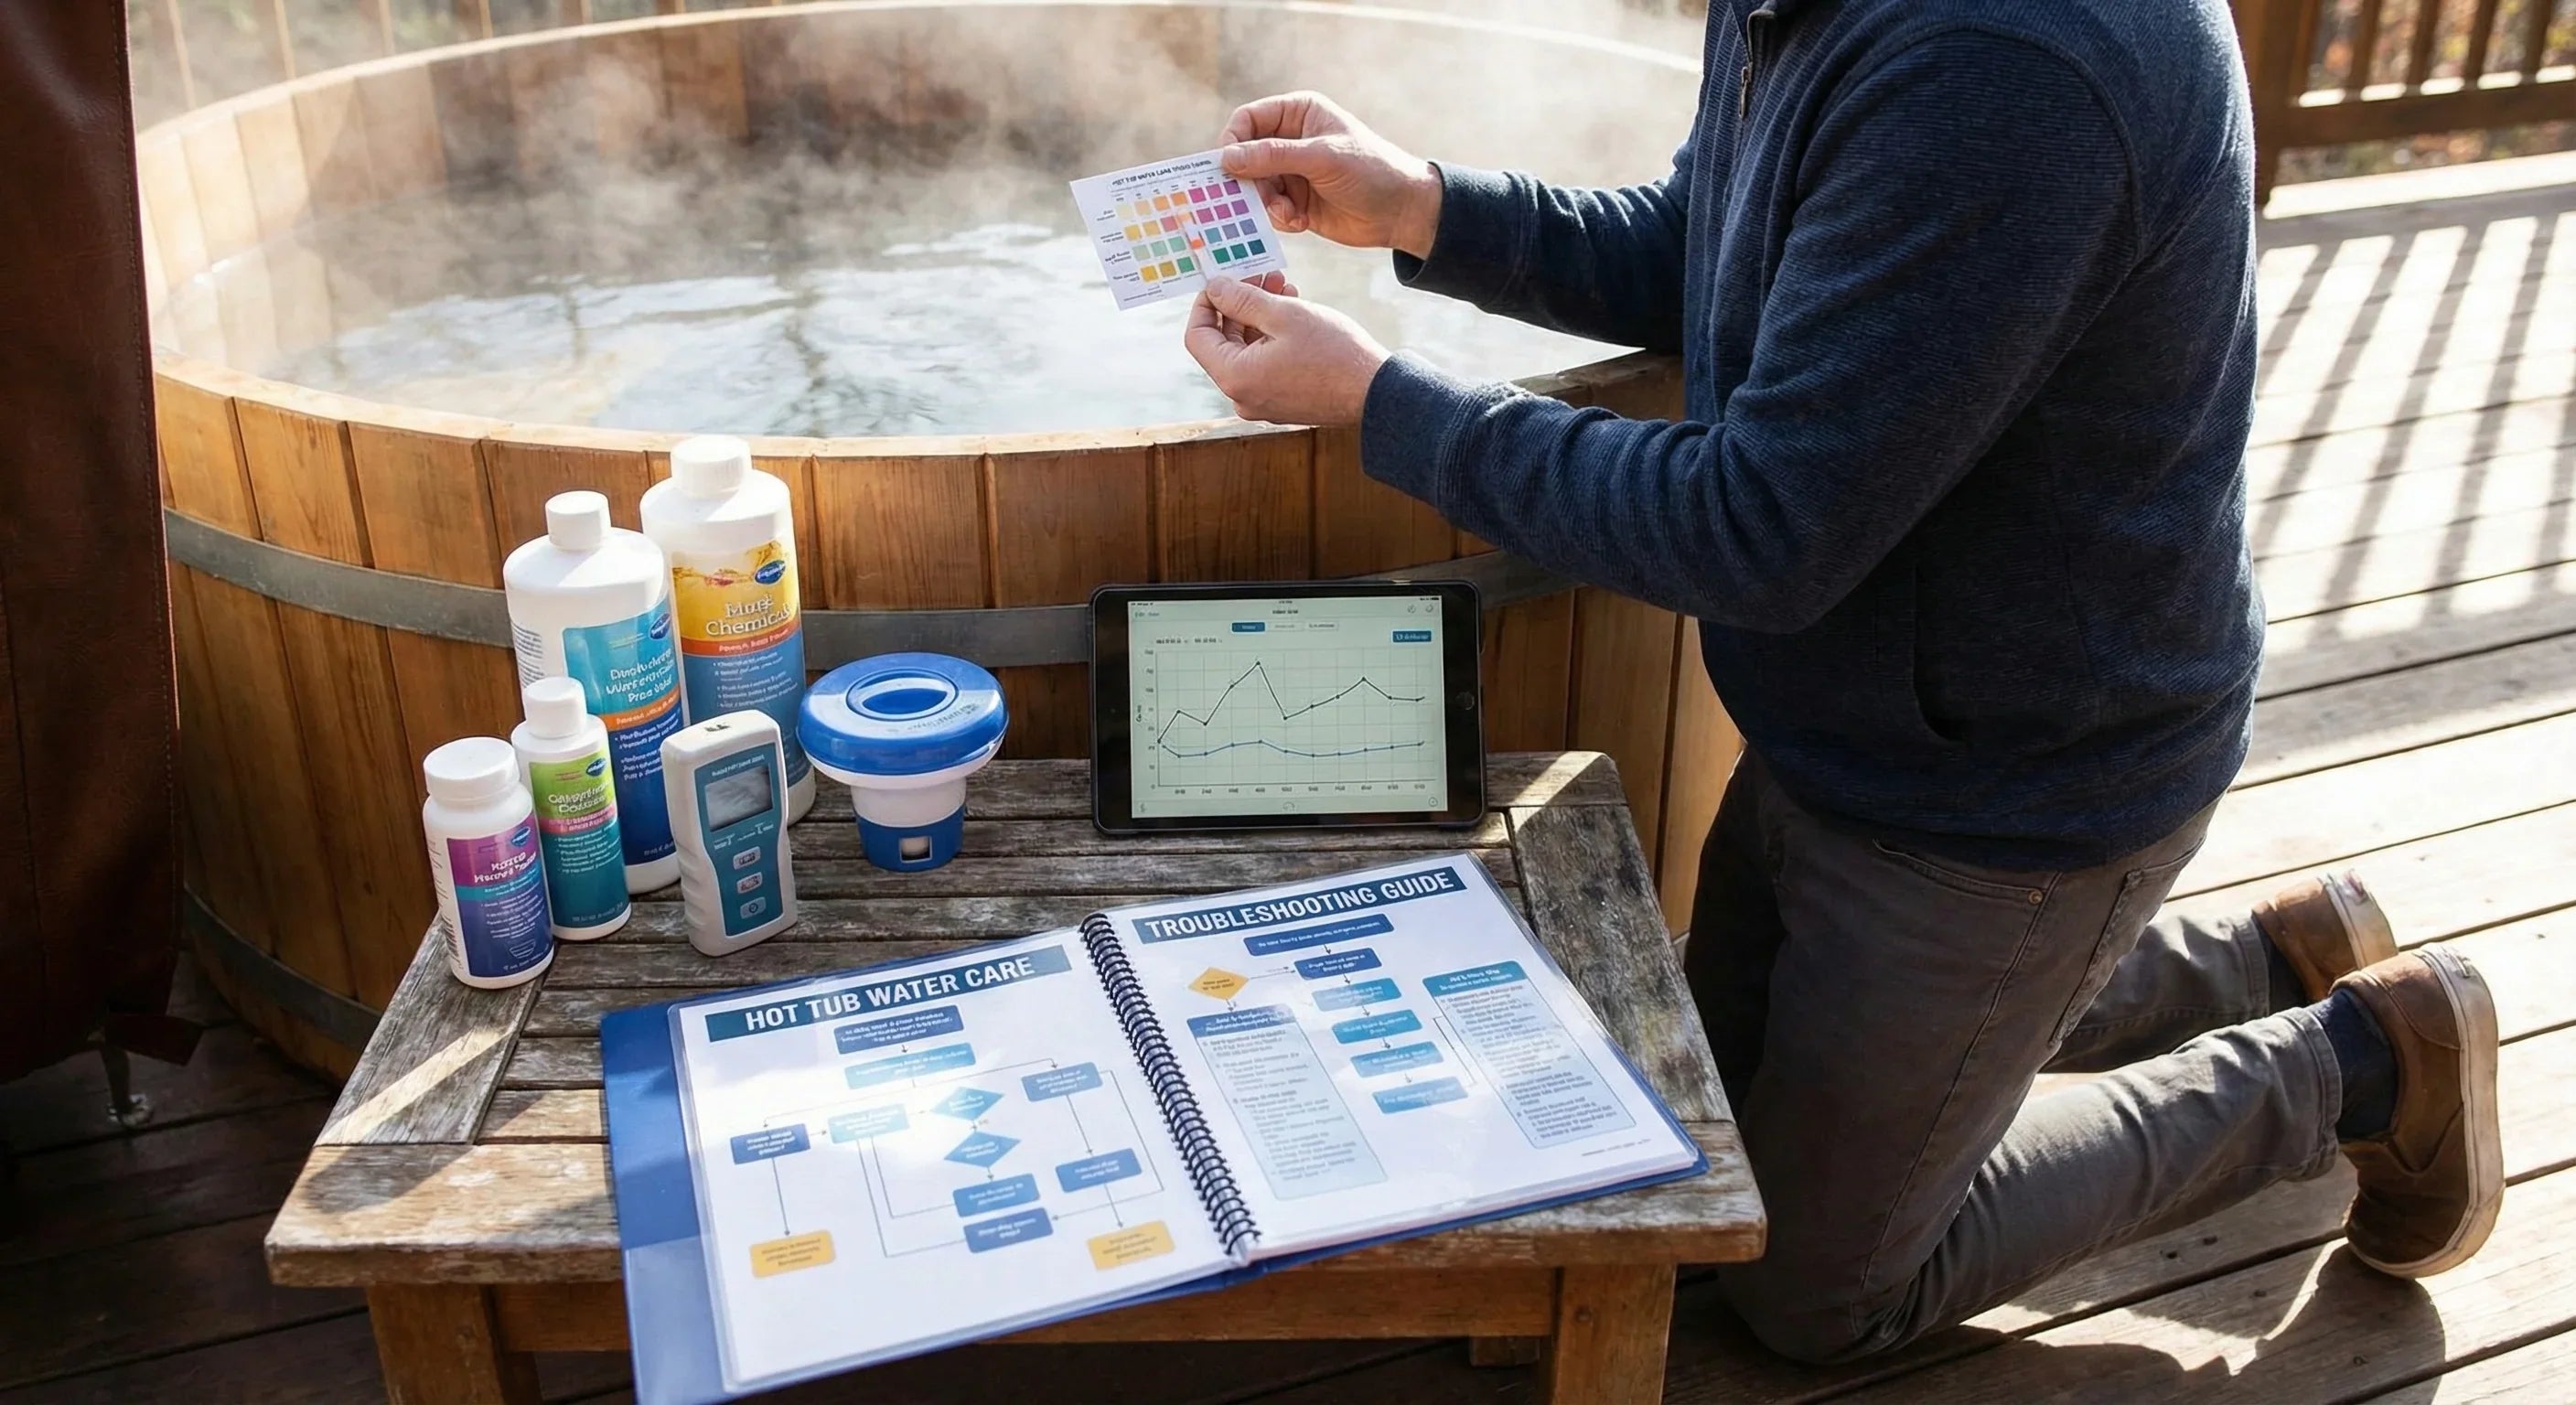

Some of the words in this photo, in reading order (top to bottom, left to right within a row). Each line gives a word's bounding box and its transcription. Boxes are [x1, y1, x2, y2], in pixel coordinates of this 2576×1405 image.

[1144, 887, 1378, 938] TROUBLESHOOTING
[1380, 872, 1454, 899] GUIDE
[746, 1003, 799, 1031] HOT
[805, 992, 861, 1019] TUB
[865, 973, 960, 1007] WATER
[965, 957, 1036, 987] CARE
